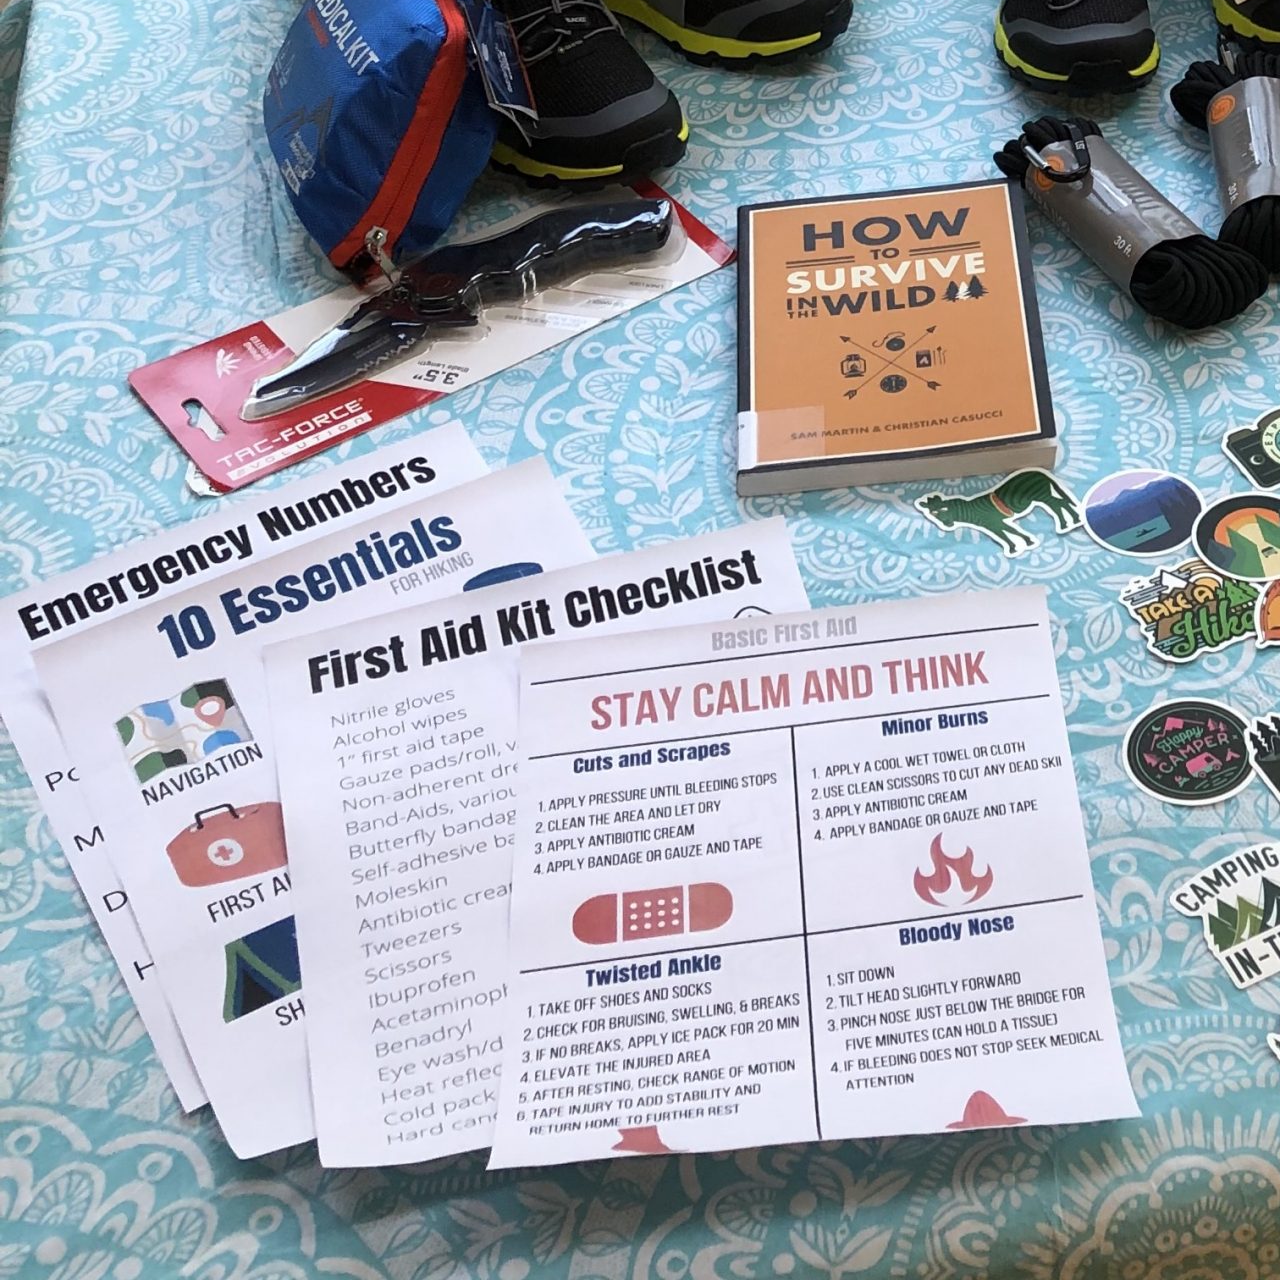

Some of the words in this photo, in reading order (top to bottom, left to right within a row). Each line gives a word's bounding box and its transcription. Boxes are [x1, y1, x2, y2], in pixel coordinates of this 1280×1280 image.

[344, 36, 380, 76] KIT
[802, 207, 970, 252] HOW
[1114, 235, 1126, 250] 30
[786, 252, 986, 294] SURVIVE
[870, 247, 900, 260] TO
[786, 296, 818, 311] IN
[788, 310, 818, 319] THE
[821, 285, 936, 316] WILD
[216, 399, 363, 467] TAC-FORCE
[790, 431, 818, 441] SAM
[821, 425, 869, 438] MARTIN
[884, 416, 949, 432] CHRISTIAN
[952, 409, 1003, 424] CASUCCI
[17, 524, 254, 641] Emergency
[256, 455, 437, 542] Numbers
[157, 605, 216, 659] 10
[219, 516, 462, 635] Essentials
[389, 572, 423, 596] FOR
[423, 551, 474, 586] HIKING
[307, 635, 409, 694] First
[420, 614, 486, 666] Aid
[496, 599, 555, 646] Kit
[564, 549, 762, 628] Checklist
[1134, 592, 1192, 625] TAKE
[1192, 585, 1215, 604] A
[711, 625, 768, 651] Basic
[774, 620, 821, 644] First
[825, 616, 857, 637] Aid
[330, 704, 389, 728] Nitrile
[395, 688, 456, 716] gloves
[591, 686, 682, 731] STAY
[693, 673, 791, 718] CALM
[802, 664, 873, 705] AND
[881, 650, 990, 695] THINK
[333, 720, 406, 749] Alcohol
[412, 708, 468, 729] wipes
[882, 714, 934, 737] Minor
[937, 710, 989, 730] Burns
[1156, 726, 1204, 753] Happy
[362, 746, 399, 765] first
[406, 736, 435, 755] aid
[440, 726, 485, 745] tape
[573, 755, 613, 774] Cuts
[618, 750, 652, 768] and
[657, 742, 731, 764] Scrapes
[812, 768, 820, 780] 1.
[824, 762, 861, 778] APPLY
[864, 760, 872, 773] A
[874, 756, 903, 772] COOL
[905, 753, 930, 767] WET
[932, 749, 971, 765] TOWEL
[973, 746, 988, 759] OR
[990, 741, 1026, 756] CLOTH
[1159, 733, 1229, 773] CAMPER
[140, 742, 264, 806] NAVIGATION
[339, 767, 403, 790] Gauze
[342, 770, 486, 813] Non-adherent
[548, 795, 586, 812] APPLY
[589, 787, 647, 806] PRESSURE
[650, 784, 682, 799] UNTIL
[684, 777, 739, 797] BLEEDING
[741, 772, 778, 788] STOPS
[345, 802, 454, 836] Band-Aids,
[349, 829, 437, 859] Butterfly
[351, 840, 488, 886] Self-adhesive
[355, 875, 448, 910] Moleskin
[1175, 847, 1280, 913] CAMPING
[207, 883, 265, 923] FIRST
[358, 898, 458, 935] Antibiotic
[360, 922, 462, 958] Tweezers
[899, 922, 963, 946] Bloody
[968, 915, 1015, 936] Nose
[364, 950, 452, 984] Scissors
[585, 960, 662, 987] Twisted
[667, 953, 722, 976] Ankle
[836, 970, 856, 986] SIT
[858, 966, 895, 983] DOWN
[369, 970, 476, 1009] Ibuprofen
[839, 993, 864, 1009] TILT
[866, 987, 900, 1004] HEAD
[902, 980, 959, 1001] SLIGHTLY
[962, 971, 1022, 992] FORWARD
[375, 1018, 472, 1058] Benadryl
[383, 1102, 435, 1127] Cold
[443, 1088, 497, 1117] pack
